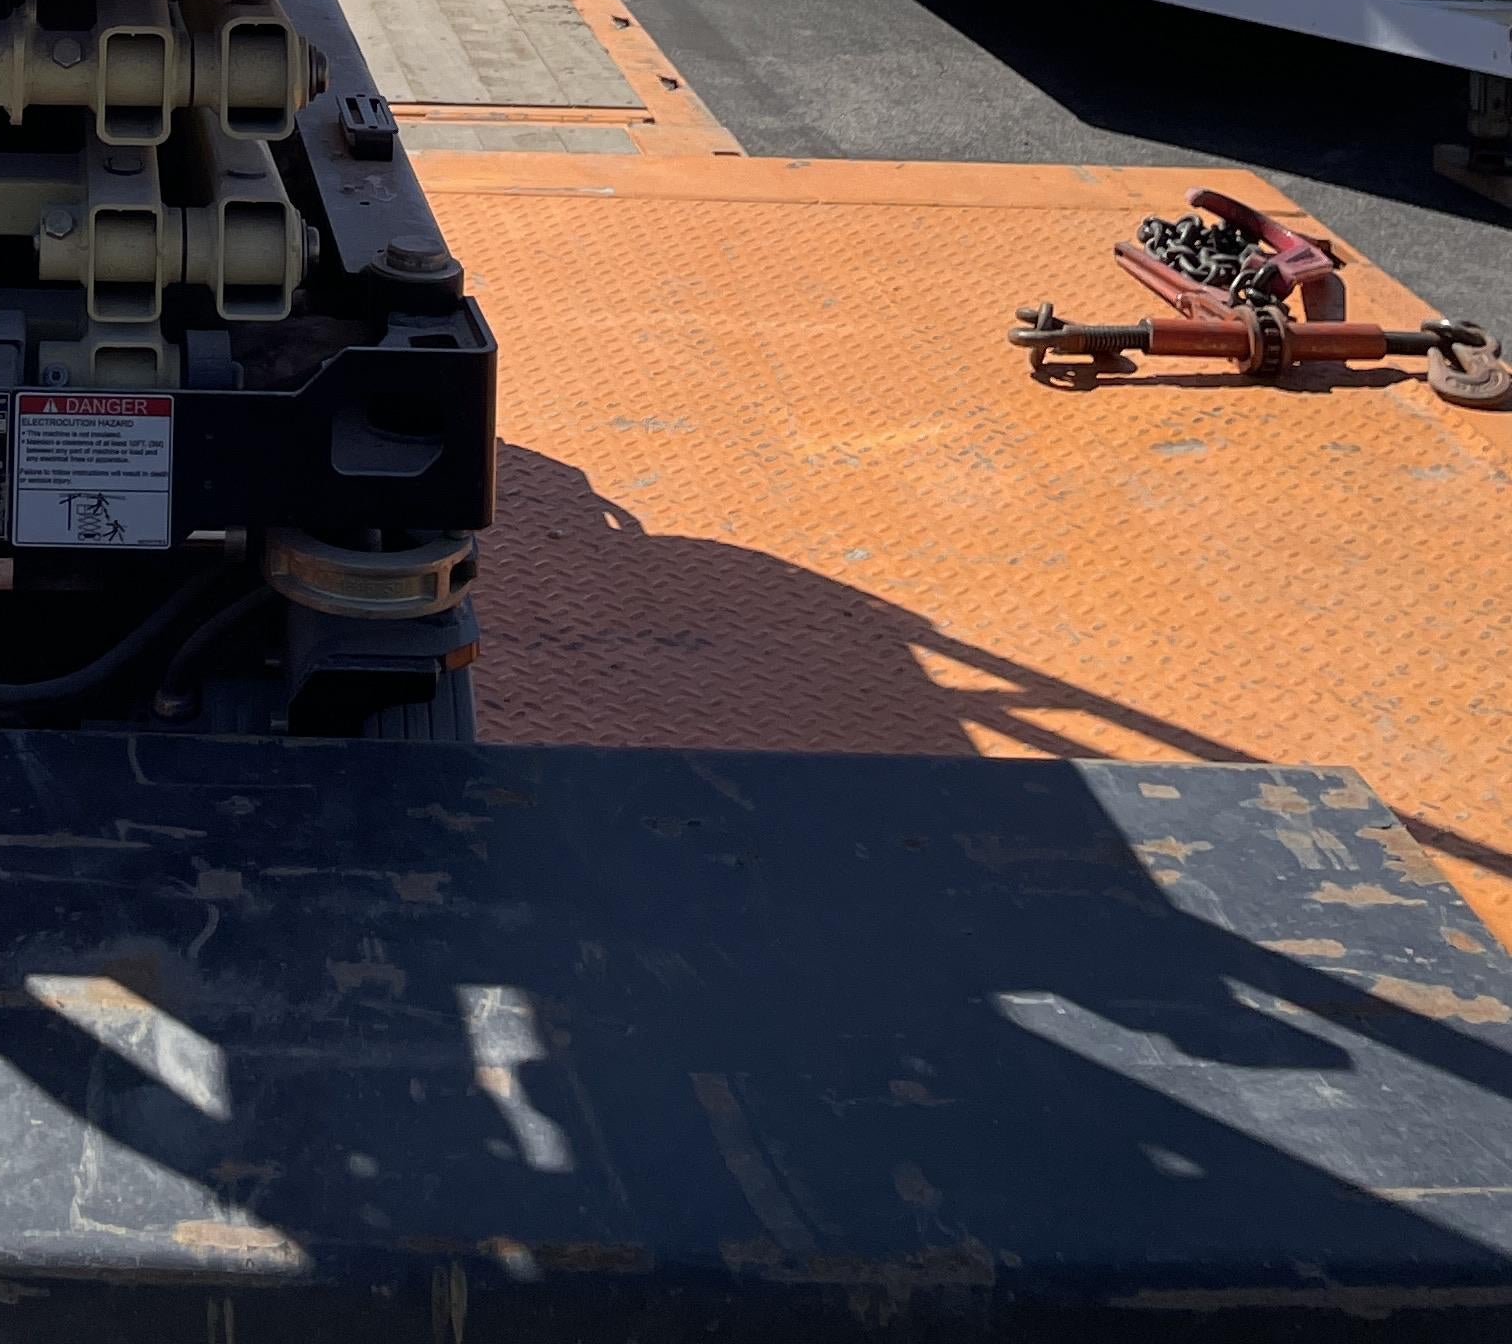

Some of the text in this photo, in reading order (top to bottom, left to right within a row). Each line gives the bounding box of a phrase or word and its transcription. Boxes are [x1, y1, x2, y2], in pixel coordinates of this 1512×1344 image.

[66, 398, 148, 415] DANGER
[21, 418, 135, 428] ELECTROCUTION HAZARD
